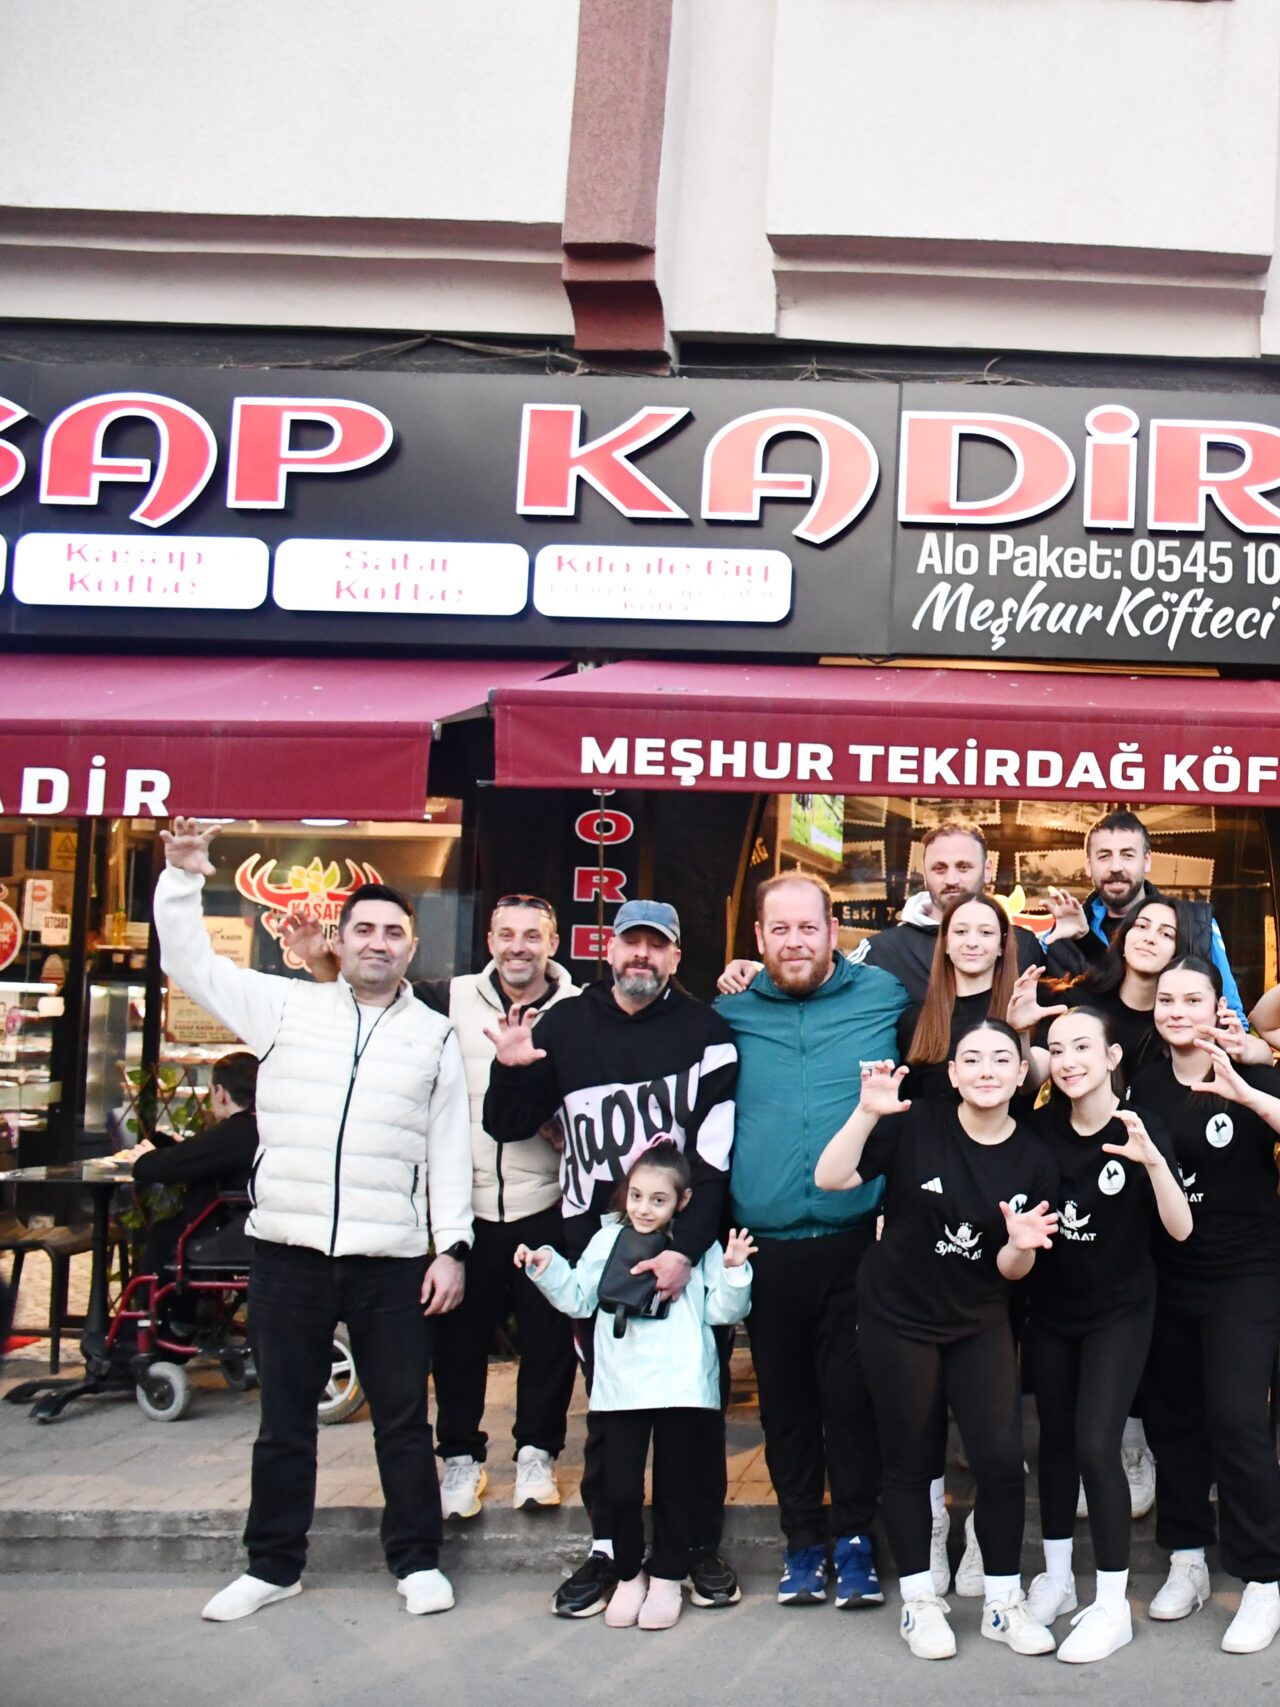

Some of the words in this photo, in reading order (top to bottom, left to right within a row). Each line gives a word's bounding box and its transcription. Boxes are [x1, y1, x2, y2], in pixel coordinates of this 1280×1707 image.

[0, 391, 394, 529] AP
[916, 531, 979, 575] Alo
[988, 533, 1123, 580] Paket:
[1130, 538, 1233, 584] 0545
[911, 579, 1103, 651] Meşhur
[0, 754, 171, 817] DİR
[580, 736, 834, 787] MEŞHUR
[848, 738, 1146, 791] TEKİRDAĞ
[570, 789, 634, 960] ORB
